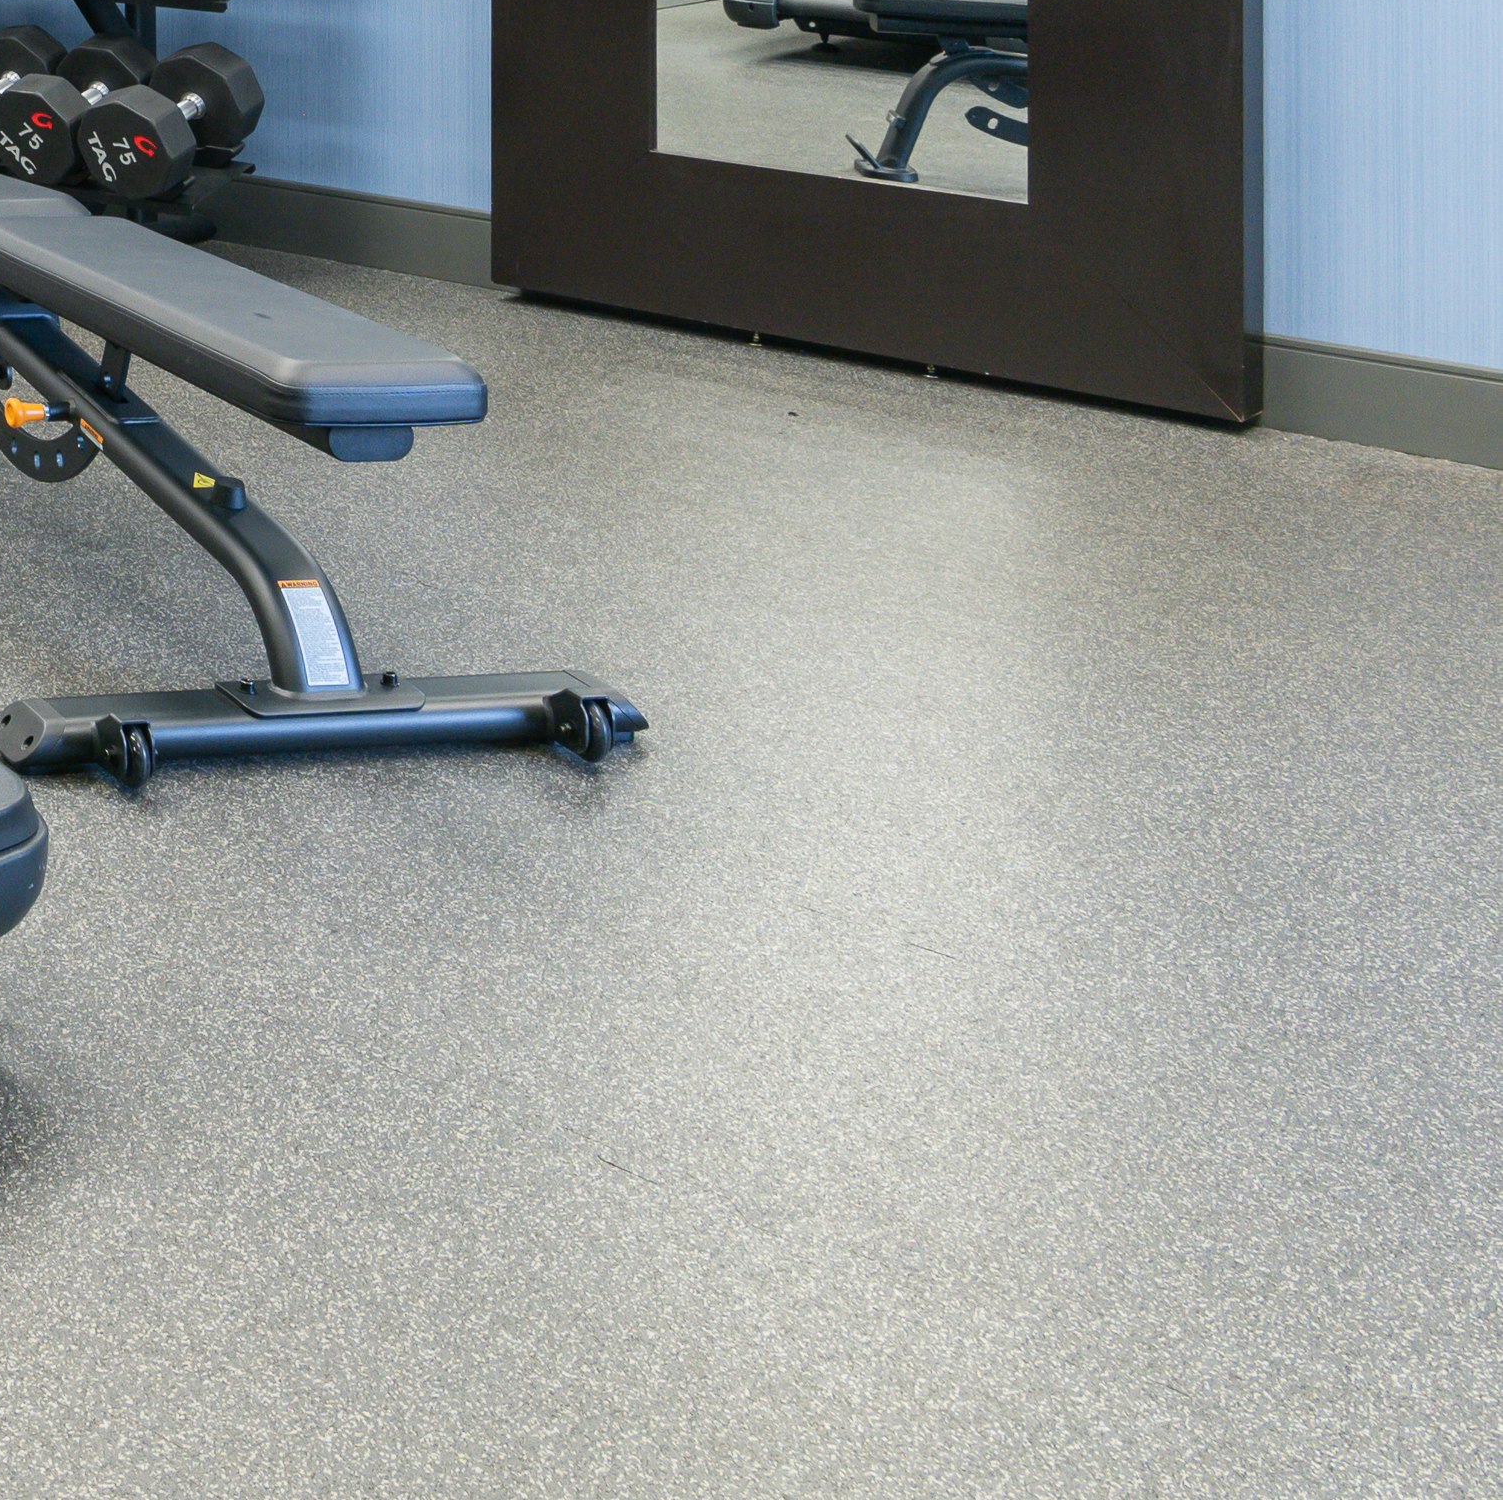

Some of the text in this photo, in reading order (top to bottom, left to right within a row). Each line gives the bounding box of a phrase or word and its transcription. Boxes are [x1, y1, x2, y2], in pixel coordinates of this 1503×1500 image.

[0, 131, 37, 175] TAG
[18, 122, 44, 150] 75
[112, 138, 137, 165] 75
[88, 131, 117, 182] TAG
